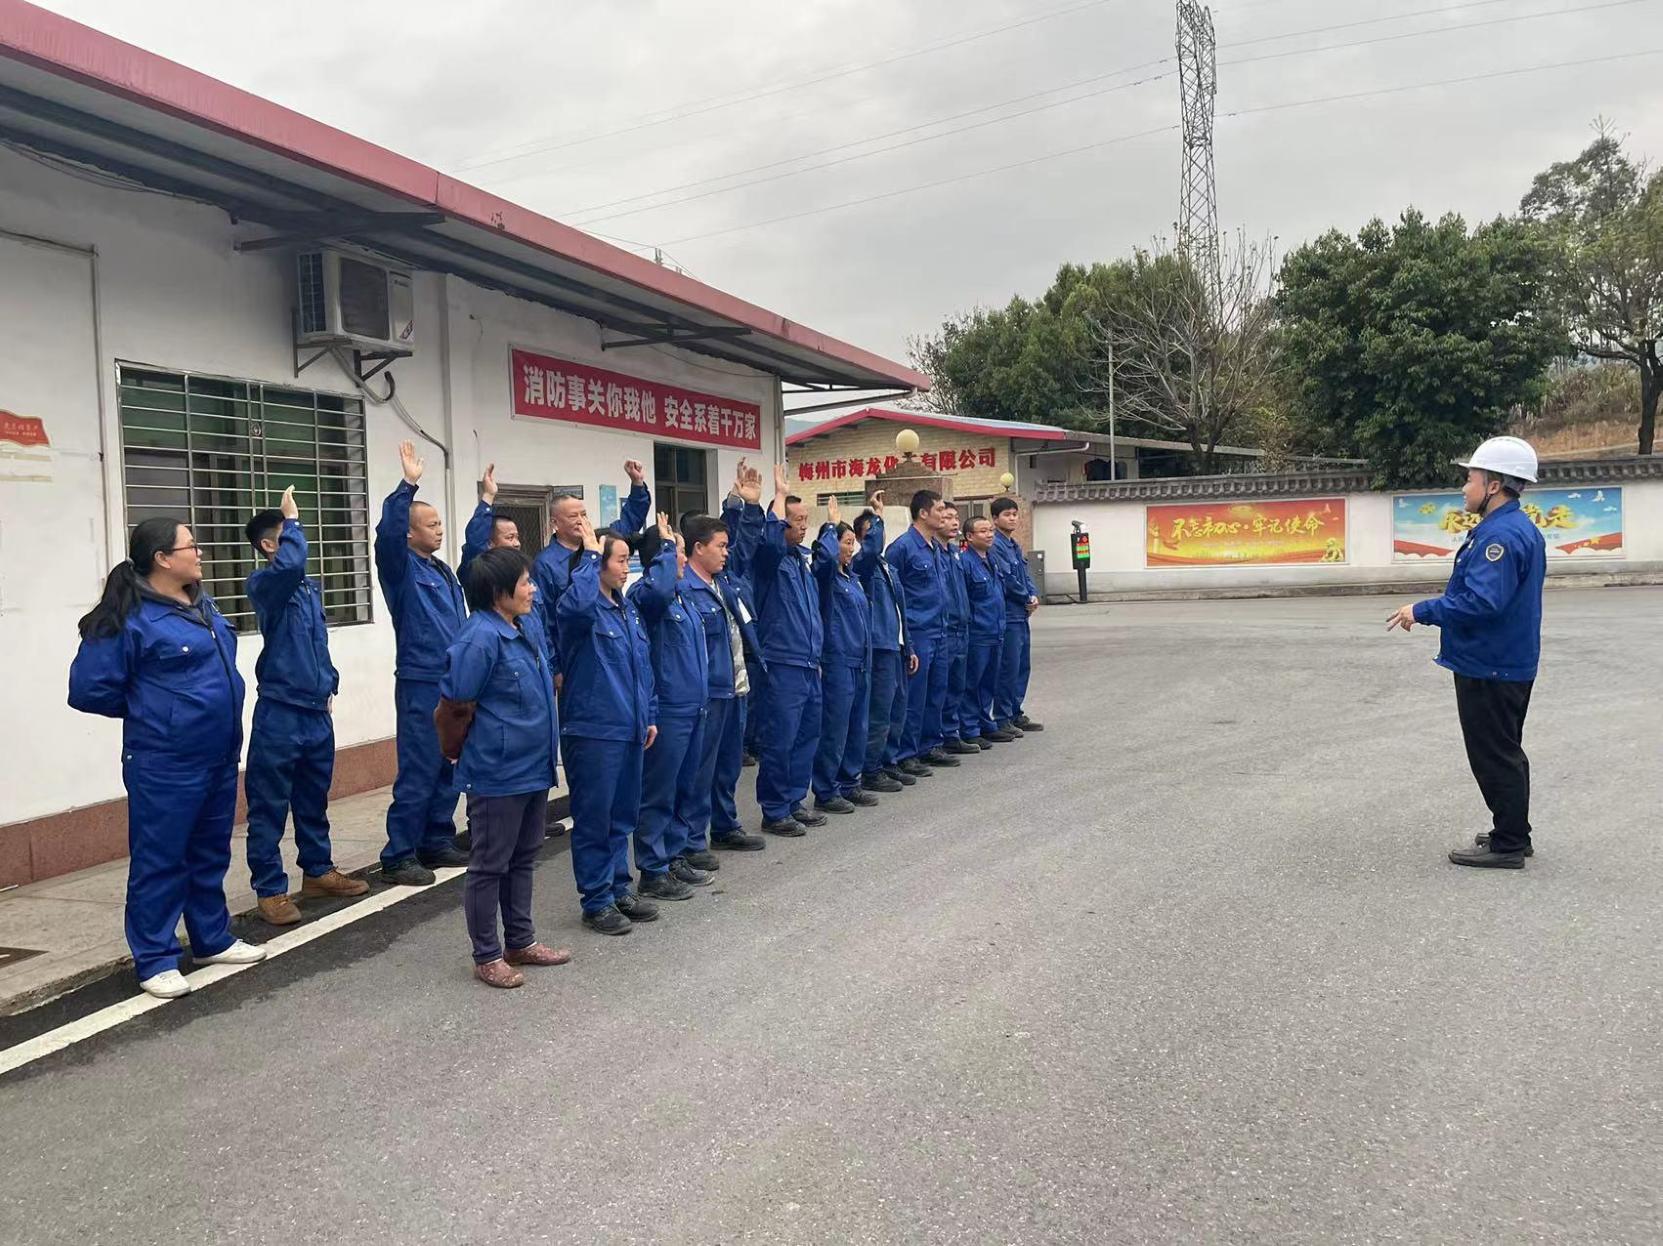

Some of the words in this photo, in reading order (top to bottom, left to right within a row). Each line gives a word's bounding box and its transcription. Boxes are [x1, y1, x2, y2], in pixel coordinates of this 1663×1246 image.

[523, 364, 656, 425] 消防事关你我他
[664, 396, 757, 440] 安全系着千万家
[798, 447, 996, 481] 梅州市海龙化有限公司
